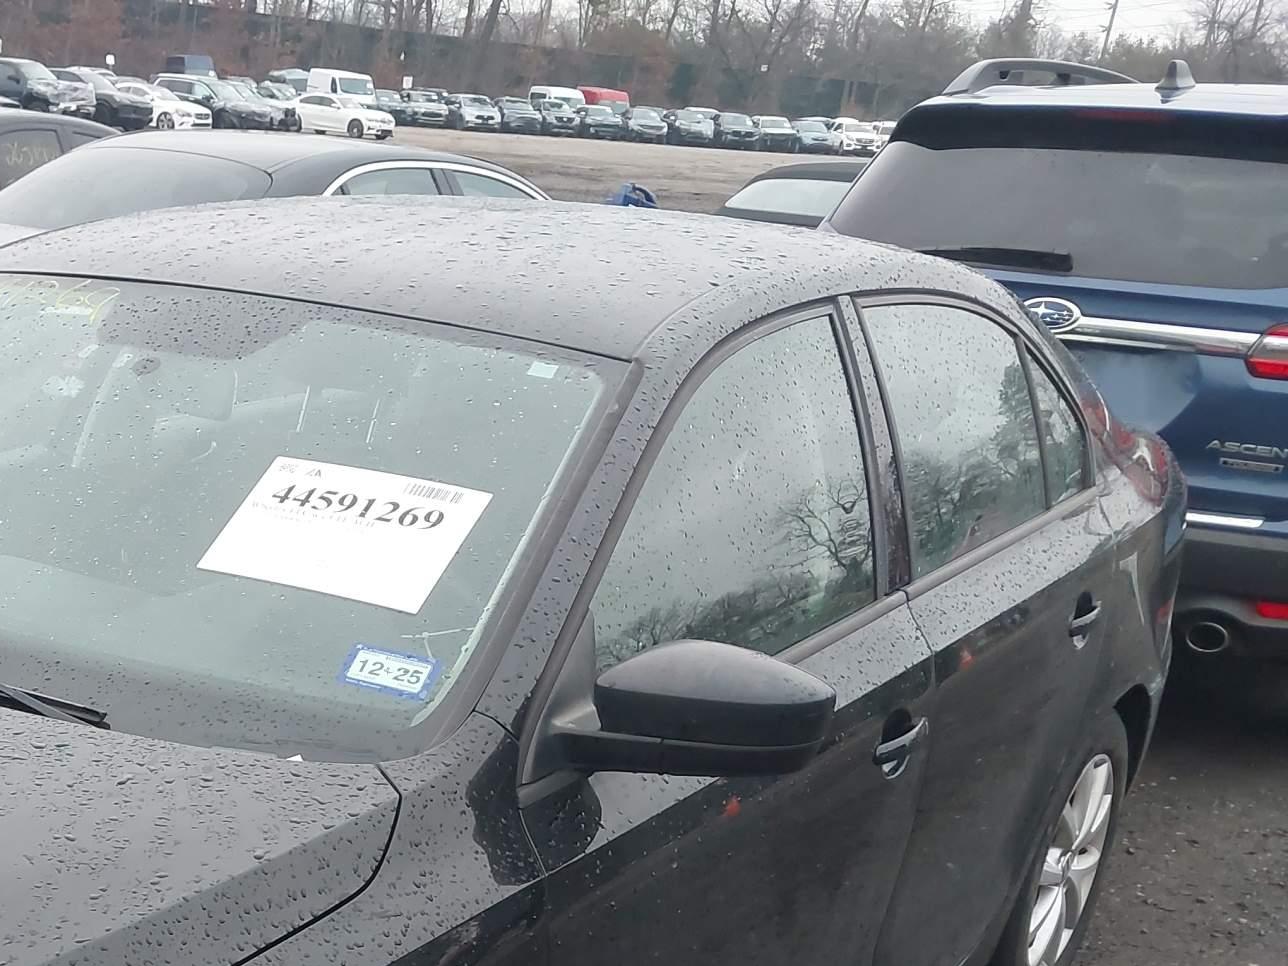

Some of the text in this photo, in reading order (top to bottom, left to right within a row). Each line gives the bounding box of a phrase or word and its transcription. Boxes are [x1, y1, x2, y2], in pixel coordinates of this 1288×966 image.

[271, 484, 445, 530] 44591269
[358, 659, 385, 677] 12
[392, 667, 424, 685] 25
